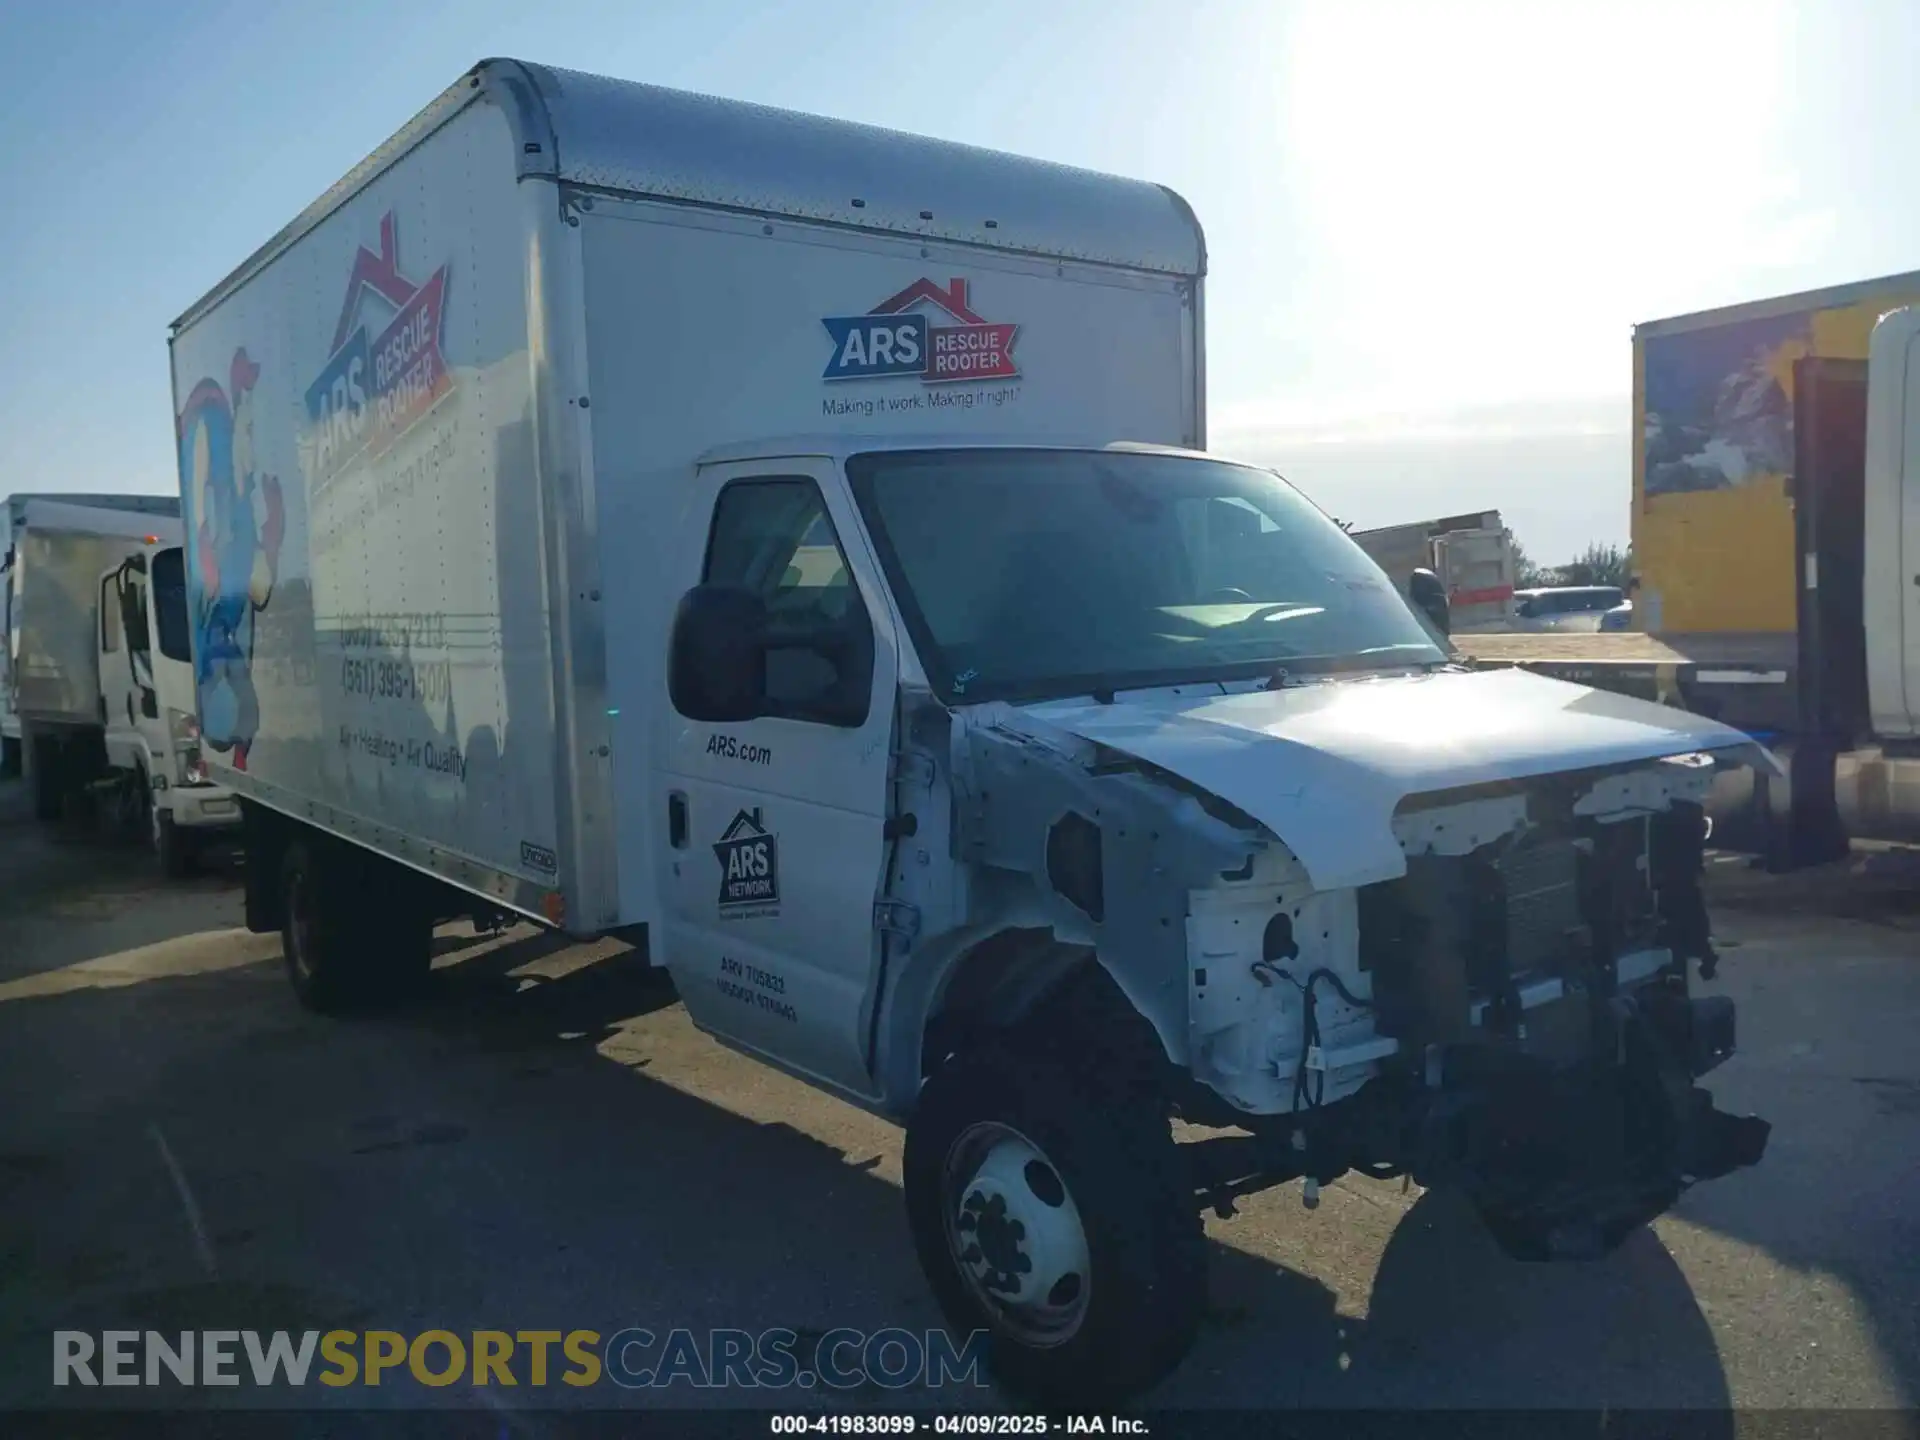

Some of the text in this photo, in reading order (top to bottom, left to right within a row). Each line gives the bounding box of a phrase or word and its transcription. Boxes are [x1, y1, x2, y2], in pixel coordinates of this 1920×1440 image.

[376, 303, 431, 390] RESCUE
[840, 325, 920, 367] ARS
[936, 332, 1000, 352] RESCUE
[936, 352, 1000, 373] ROOTER
[377, 352, 434, 433] ROOTER
[822, 399, 873, 417] Making
[876, 396, 888, 412] it
[888, 395, 924, 411] work.
[928, 391, 973, 409] Making
[975, 389, 985, 403] it
[317, 355, 367, 470] ARS
[424, 739, 468, 783] Quality
[706, 733, 771, 766] ARS.com
[727, 842, 769, 881] ARS
[728, 878, 771, 898] NETWORK
